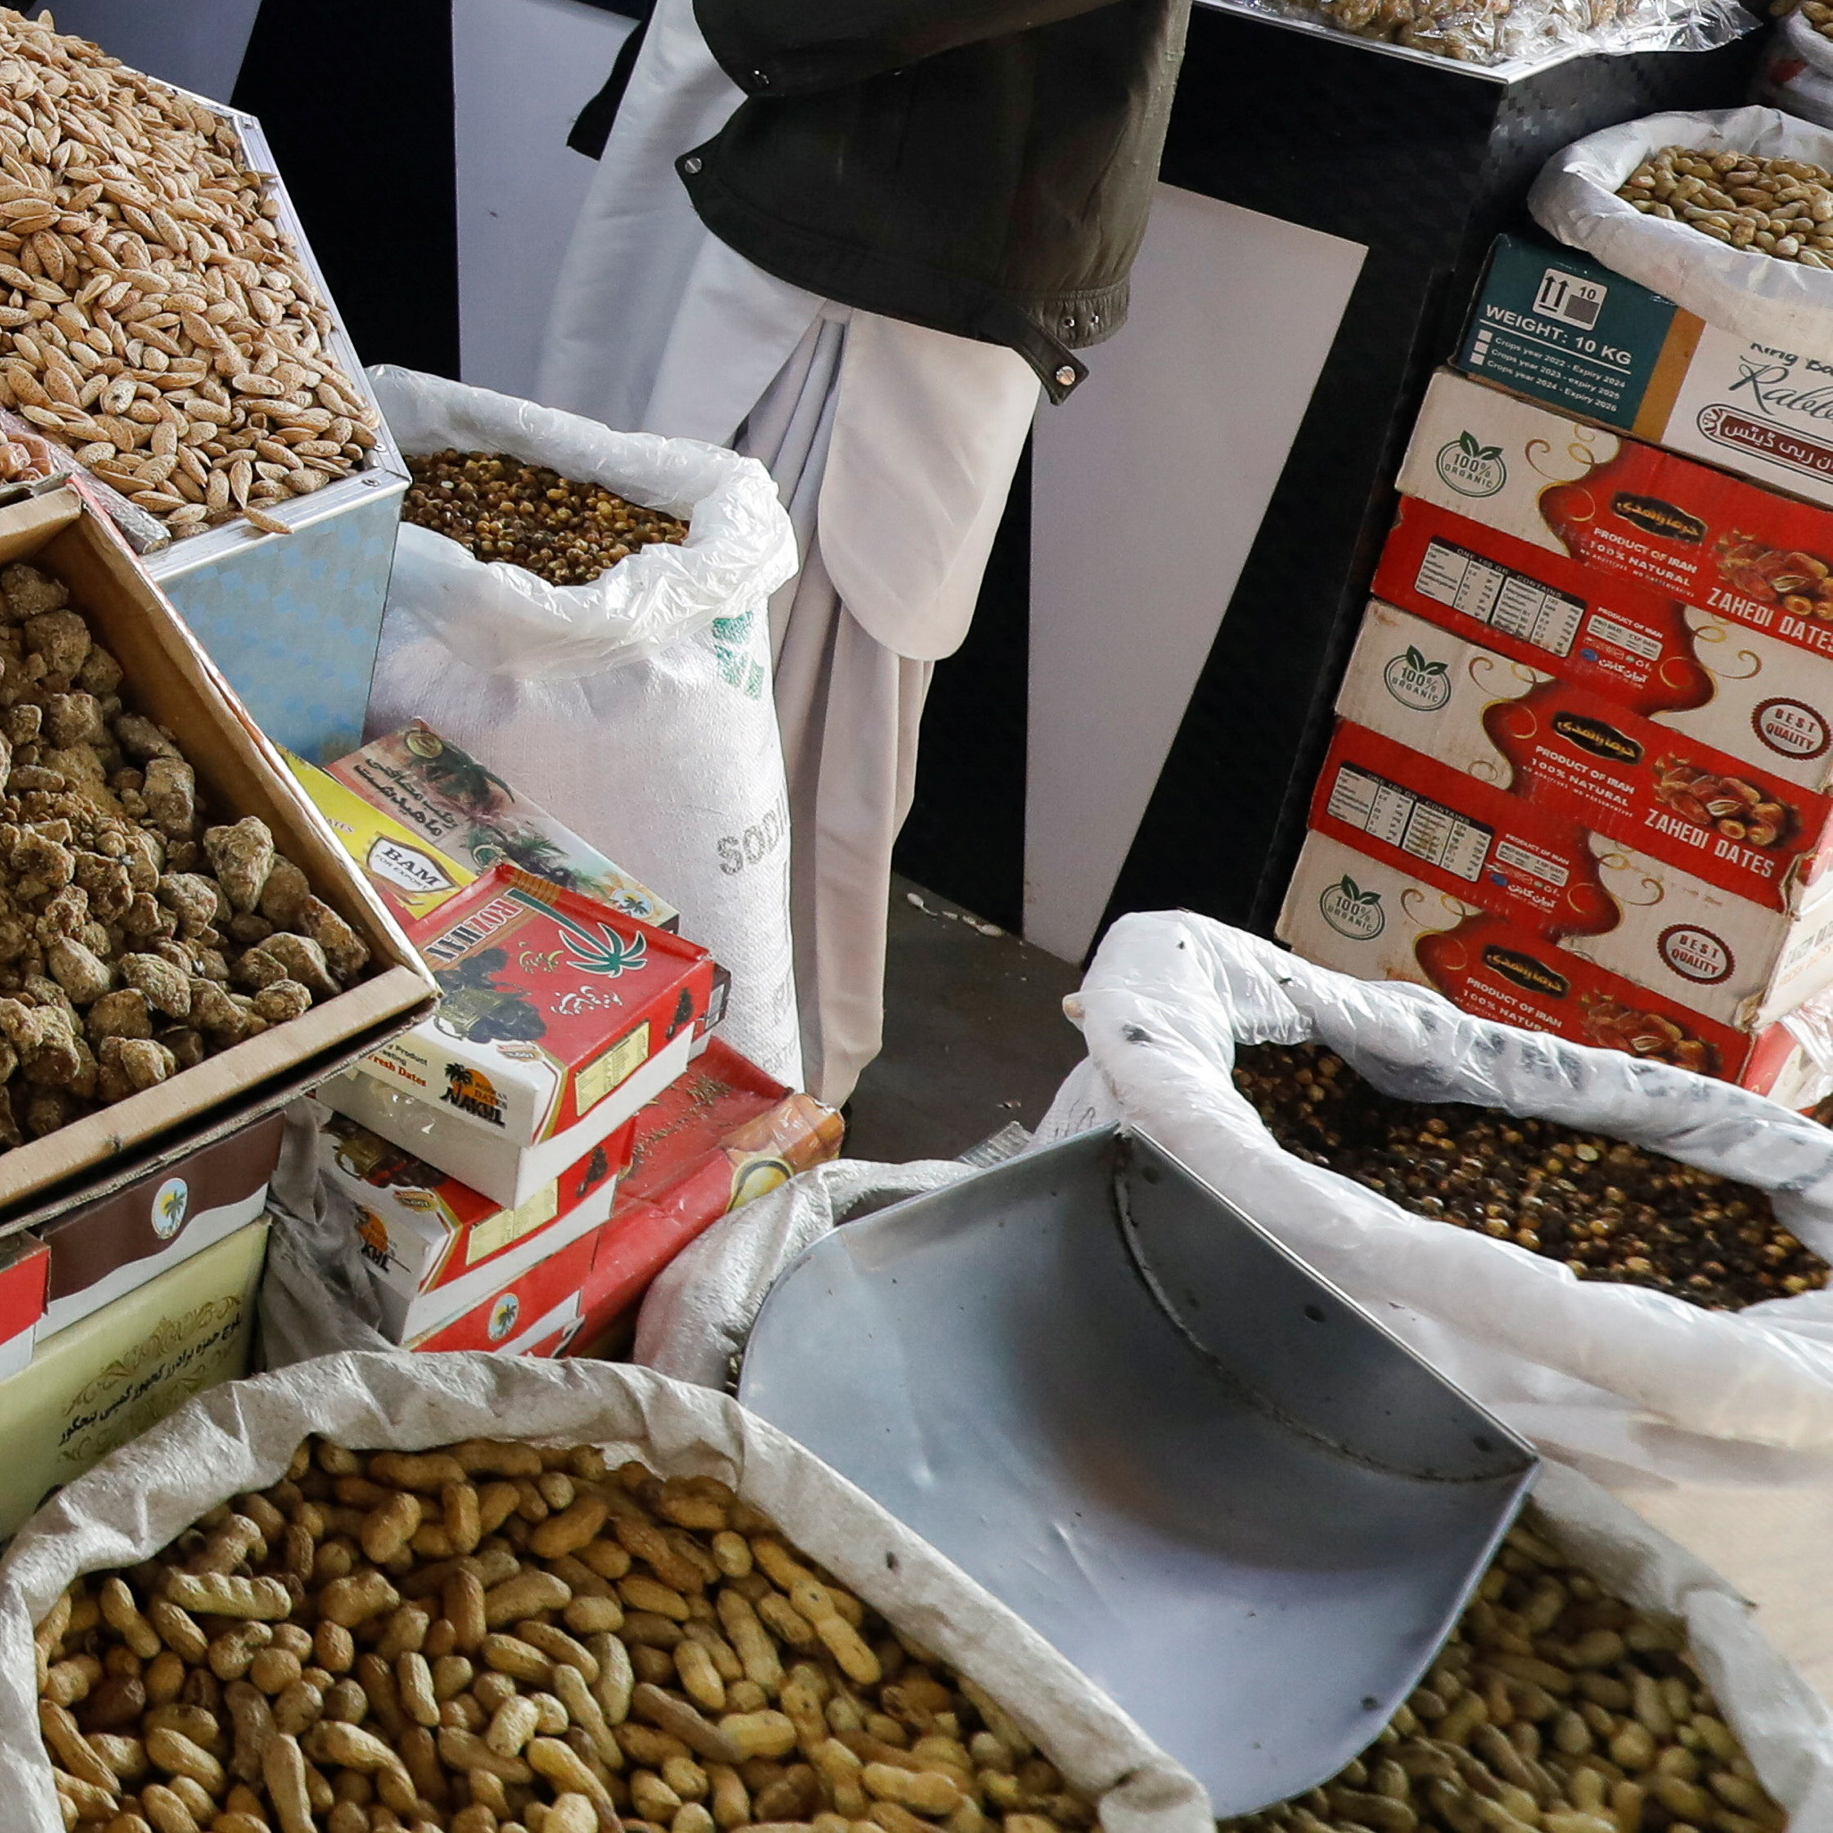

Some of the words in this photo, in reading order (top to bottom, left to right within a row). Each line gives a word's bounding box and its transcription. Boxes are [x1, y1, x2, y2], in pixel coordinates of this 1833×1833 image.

[1579, 286, 1597, 300] 10
[1484, 304, 1569, 345] WEIGHT:
[1575, 334, 1597, 354] 10
[1601, 344, 1633, 366] KG
[1452, 452, 1492, 479] 100%
[1593, 527, 1650, 555] PRODUCT
[1651, 548, 1666, 562] OF
[1668, 555, 1697, 573] IRAN
[1628, 554, 1691, 588] NATURAL
[1706, 587, 1774, 624] ZAHEDI
[1400, 667, 1438, 691] 100%
[1775, 706, 1816, 734] BEST
[1765, 721, 1817, 751] QUALITY
[1535, 745, 1586, 775] PRODUCT
[1588, 766, 1604, 780] OF
[1606, 775, 1635, 794] IRAN
[1568, 775, 1630, 807] NATURAL
[1644, 808, 1708, 850] ZAHEDI
[1713, 840, 1776, 880] DATES
[379, 844, 444, 889] BAM
[1334, 895, 1372, 922] 100%
[1671, 948, 1720, 977] QUALITY
[1677, 935, 1719, 959] BEST
[1466, 976, 1518, 1007] PRODUCT
[1519, 1001, 1536, 1014] OF
[1536, 1006, 1563, 1028] IRAN
[396, 1065, 427, 1088] Dates
